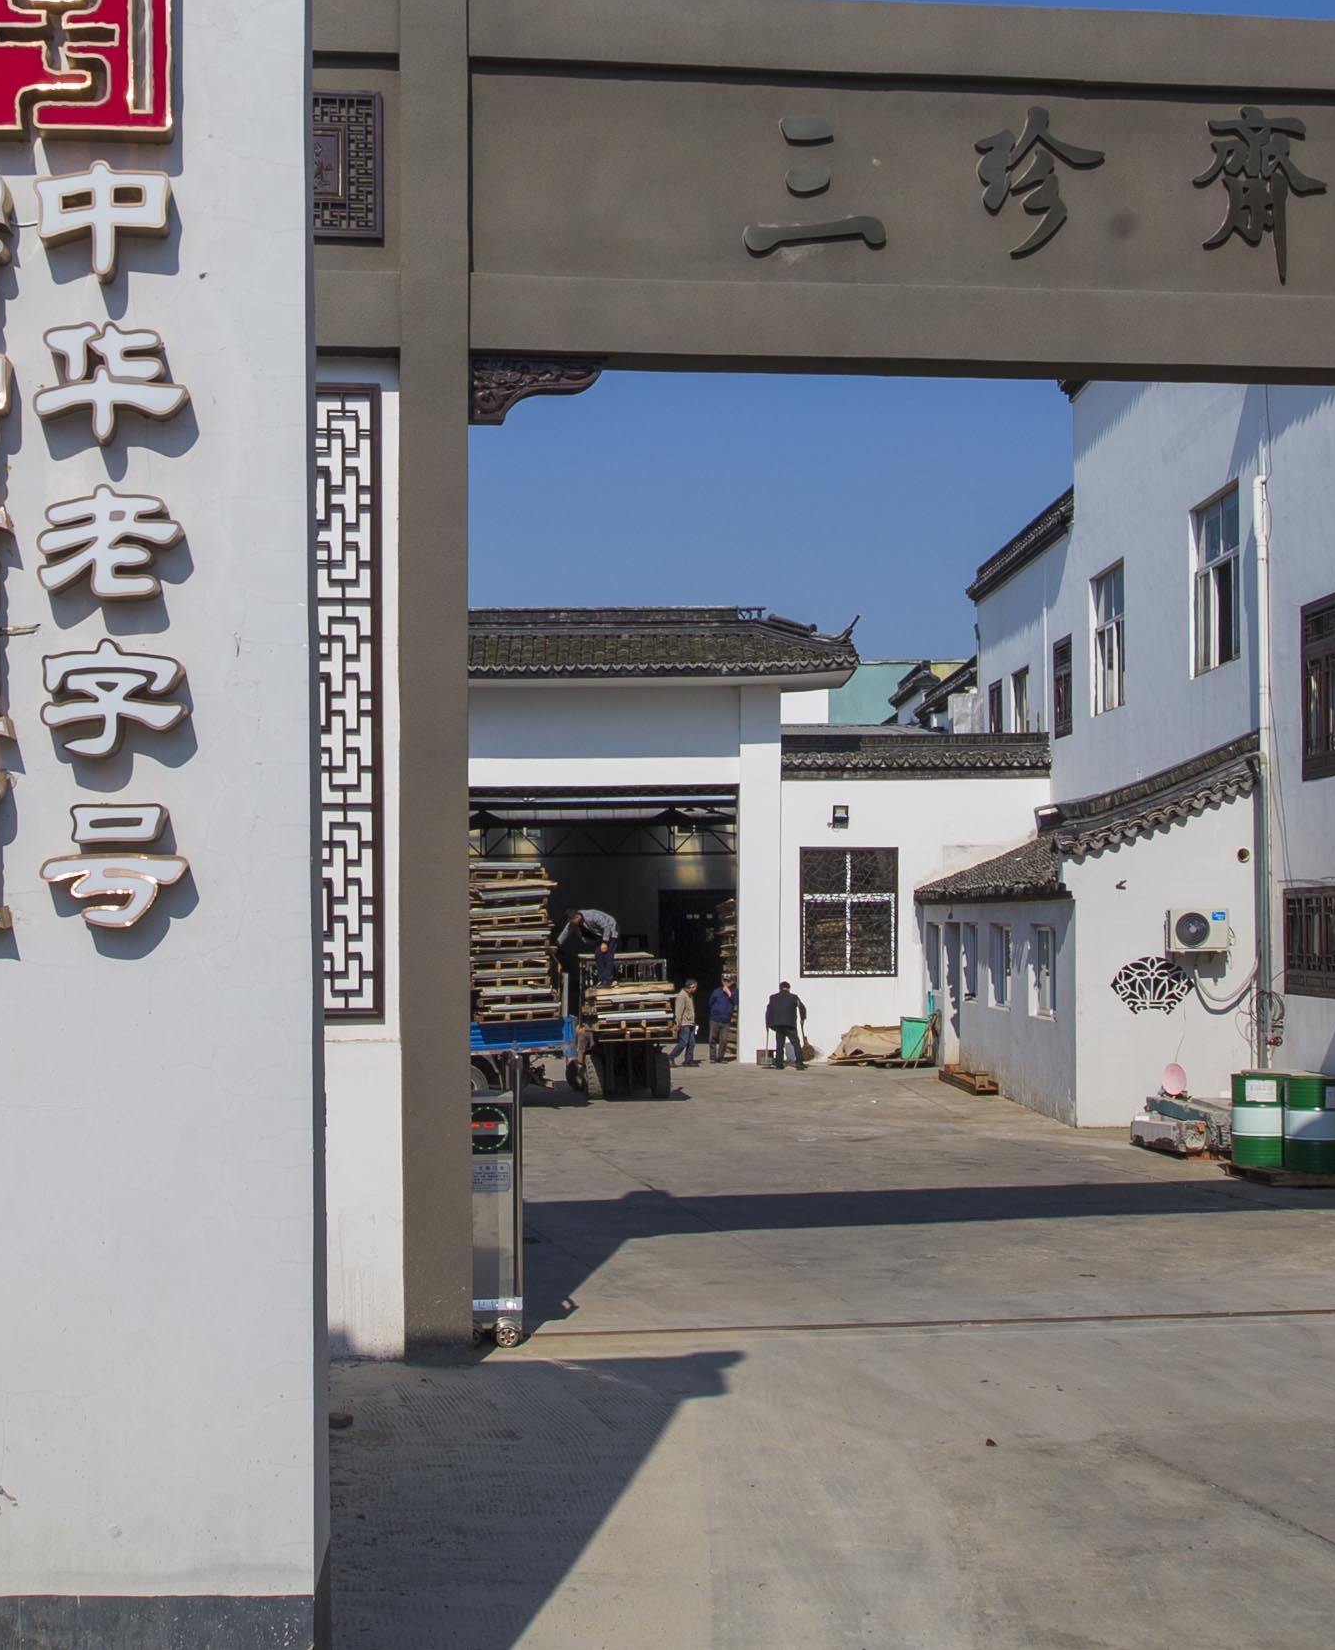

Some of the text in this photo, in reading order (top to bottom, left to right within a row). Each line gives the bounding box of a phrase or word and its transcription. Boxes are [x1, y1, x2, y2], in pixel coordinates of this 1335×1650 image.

[33, 159, 191, 928] 中华老字号
